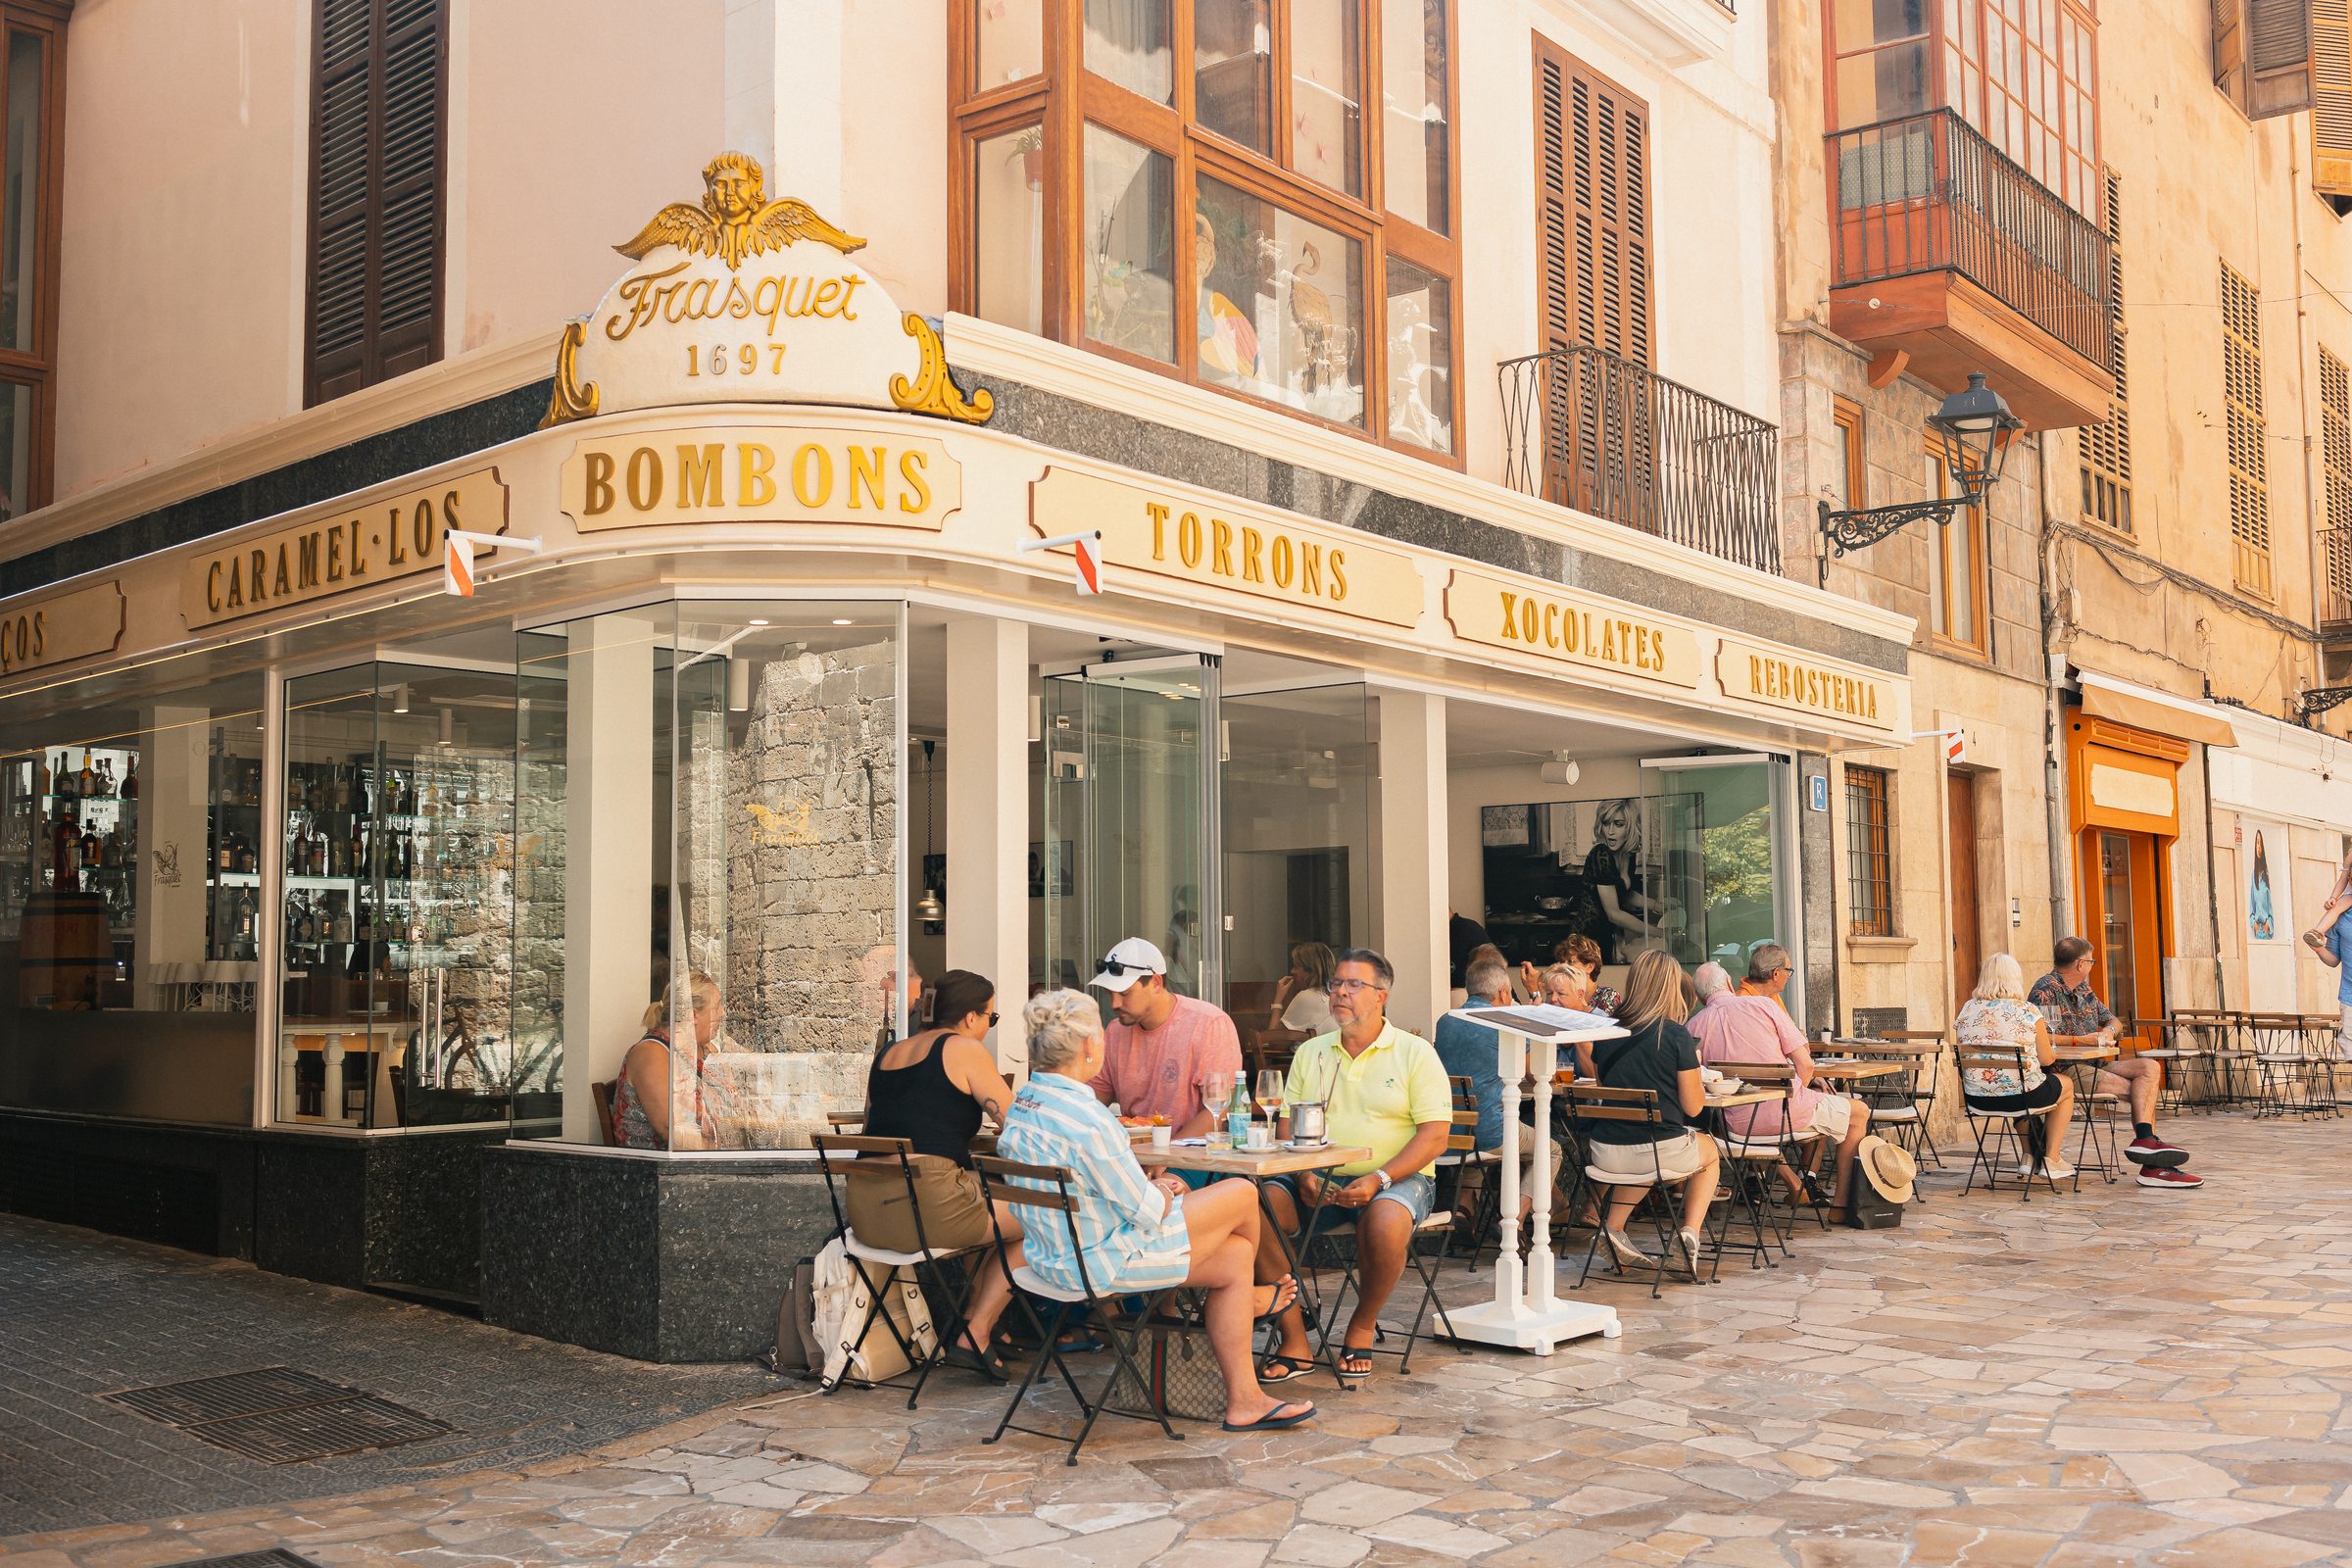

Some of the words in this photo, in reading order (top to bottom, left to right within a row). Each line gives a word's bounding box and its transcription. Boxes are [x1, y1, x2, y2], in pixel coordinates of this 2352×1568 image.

[606, 261, 866, 341] Frasquet
[686, 343, 787, 376] 1697
[583, 442, 932, 515] BOMBONS
[1147, 502, 1348, 602] TORRONS
[1501, 592, 1665, 672] XOCOLATES
[1749, 655, 1879, 719] REBOSTERIA
[1816, 782, 1823, 800] R
